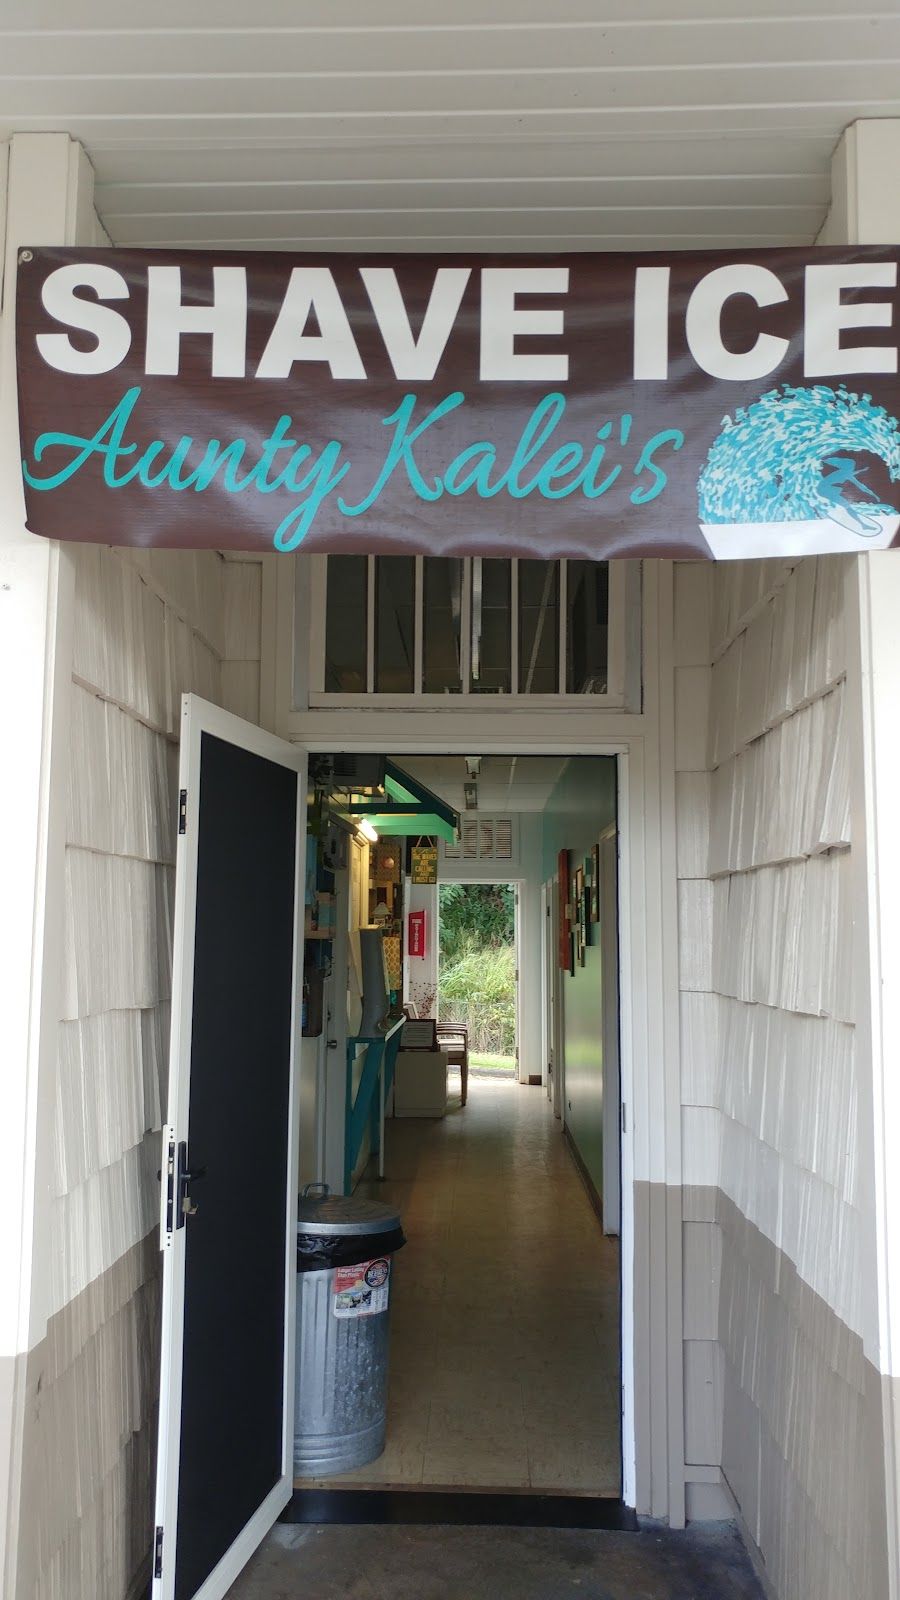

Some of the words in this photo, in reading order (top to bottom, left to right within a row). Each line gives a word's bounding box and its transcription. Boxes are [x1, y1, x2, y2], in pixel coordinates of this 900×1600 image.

[35, 263, 569, 380] SHAVE
[633, 262, 899, 380] ICE
[23, 386, 352, 553] Aunty
[336, 390, 684, 518] Kalei's
